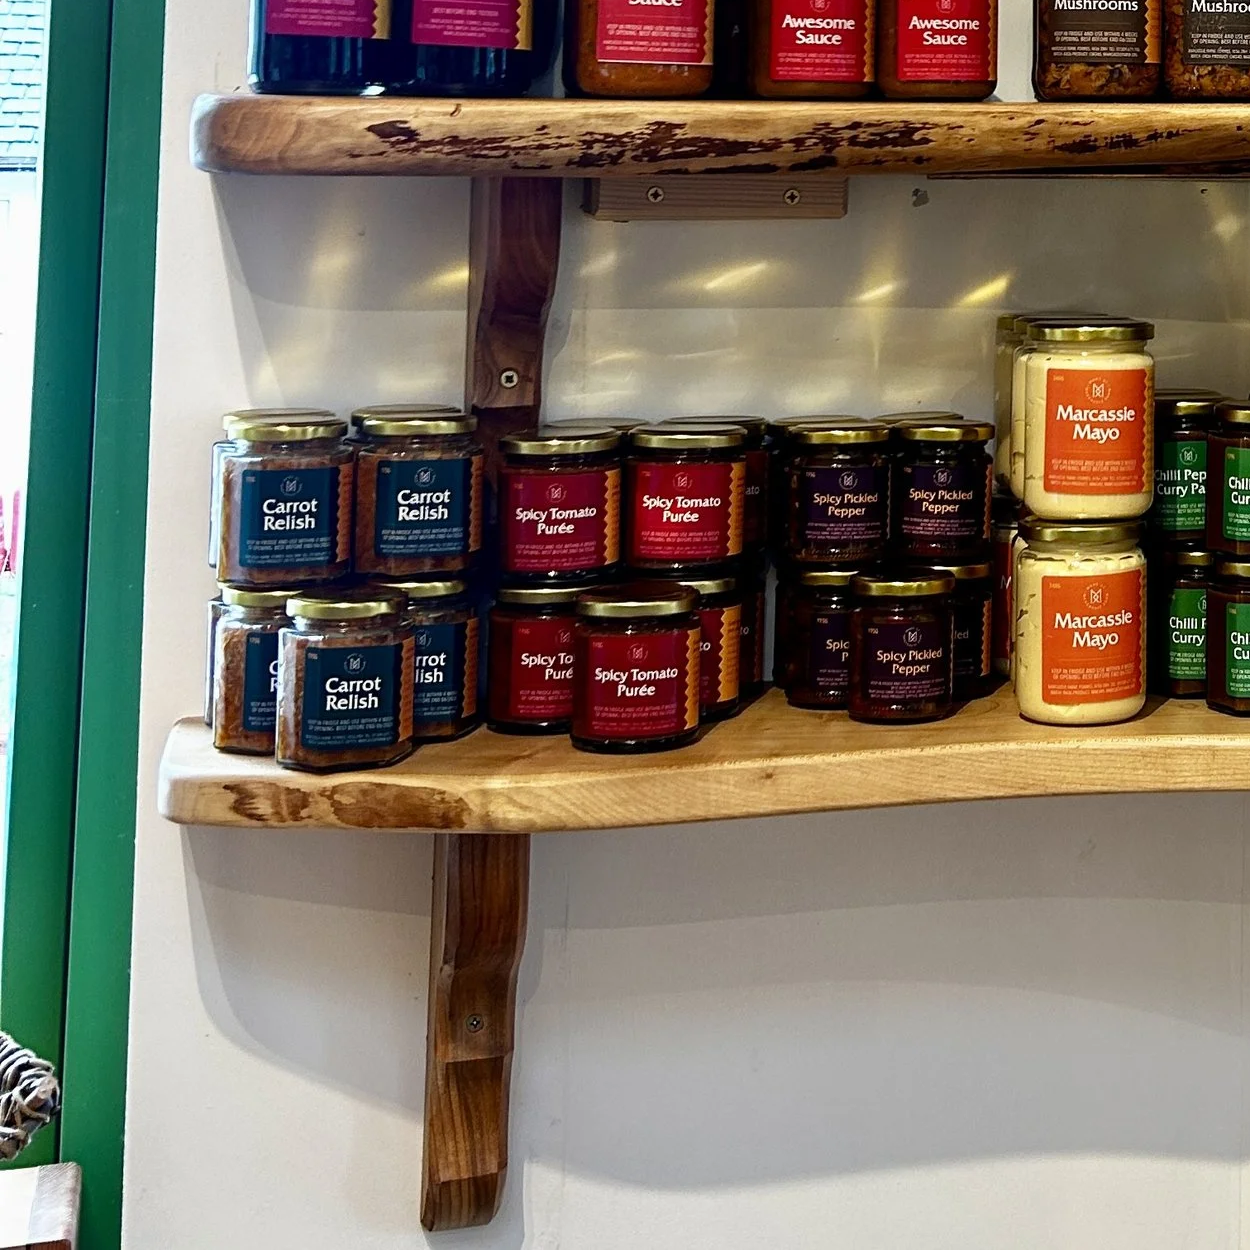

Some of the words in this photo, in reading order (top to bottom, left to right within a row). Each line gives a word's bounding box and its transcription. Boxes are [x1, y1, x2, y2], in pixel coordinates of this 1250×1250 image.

[782, 14, 855, 29] Awesome
[909, 16, 979, 30] Awesome
[796, 31, 841, 44] Sauce
[923, 31, 967, 45] Sauce
[1056, 405, 1135, 421] Marcassie
[1073, 424, 1119, 444] Mayo
[1184, 470, 1207, 483] Pep
[397, 489, 451, 505] Carrot
[909, 488, 936, 501] Spicy
[938, 490, 973, 501] Pickled
[1157, 484, 1188, 498] Curry
[263, 498, 317, 515] Carrot
[642, 495, 673, 510] Spicy
[676, 495, 721, 508] Tomato
[813, 493, 842, 506] Spicy
[844, 493, 878, 504] Pickled
[398, 505, 448, 521] Relish
[516, 508, 548, 523] Spicy
[550, 507, 597, 520] Tomato
[828, 506, 866, 518] Pepper
[922, 501, 960, 514] Pepper
[264, 515, 316, 531] Relish
[663, 510, 699, 523] Purée
[537, 522, 574, 535] Purée
[1054, 610, 1132, 629] Marcassie
[1169, 617, 1198, 629] Chilli
[826, 638, 849, 652] Spic
[1072, 632, 1118, 650] Mayo
[1172, 631, 1205, 645] Curry
[415, 652, 446, 667] rrot
[521, 653, 554, 669] Spicy
[877, 650, 906, 663] Spicy
[908, 648, 942, 660] Pickled
[415, 668, 444, 683] lish
[545, 667, 574, 681] Puré
[595, 667, 628, 683] Spicy
[631, 667, 678, 681] Tomato
[892, 663, 930, 676] Pepper
[325, 676, 381, 694] Carrot
[617, 684, 656, 697] Purée
[326, 693, 379, 710] Relish
